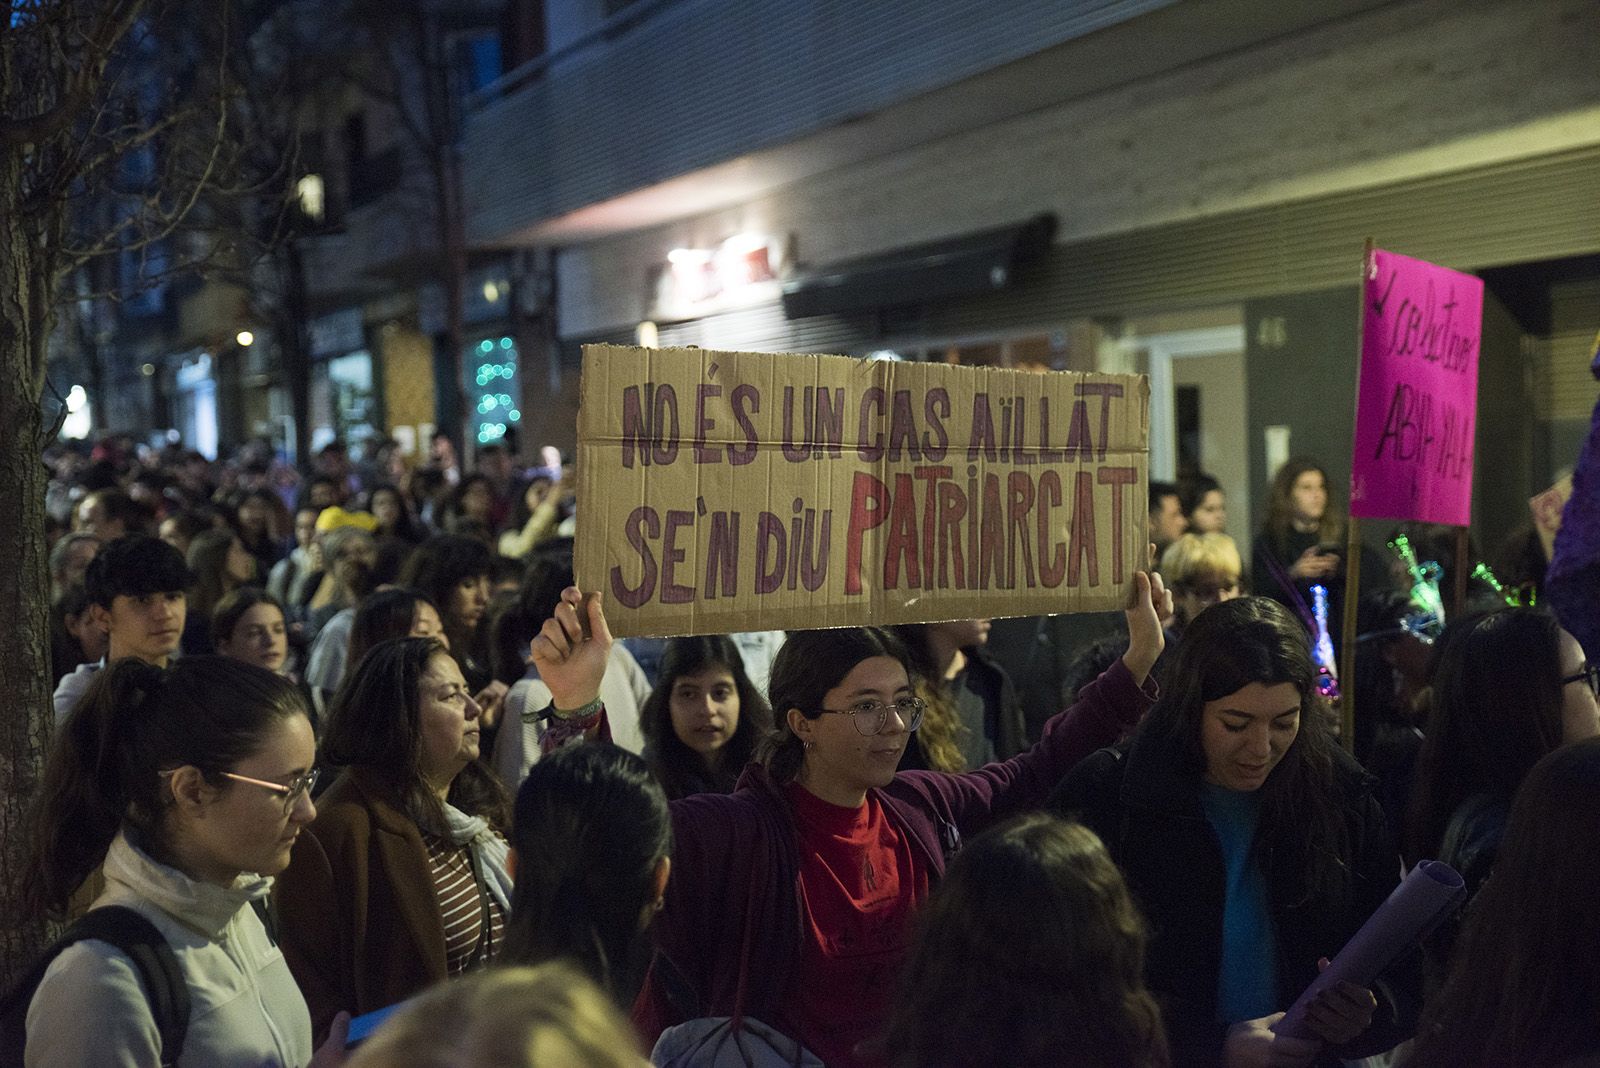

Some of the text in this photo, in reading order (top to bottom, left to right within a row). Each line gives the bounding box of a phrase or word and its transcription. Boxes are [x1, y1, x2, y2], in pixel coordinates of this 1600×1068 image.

[622, 362, 1123, 469] NO ÉS UN CAS AÏLLAT
[610, 496, 740, 609] SE'N
